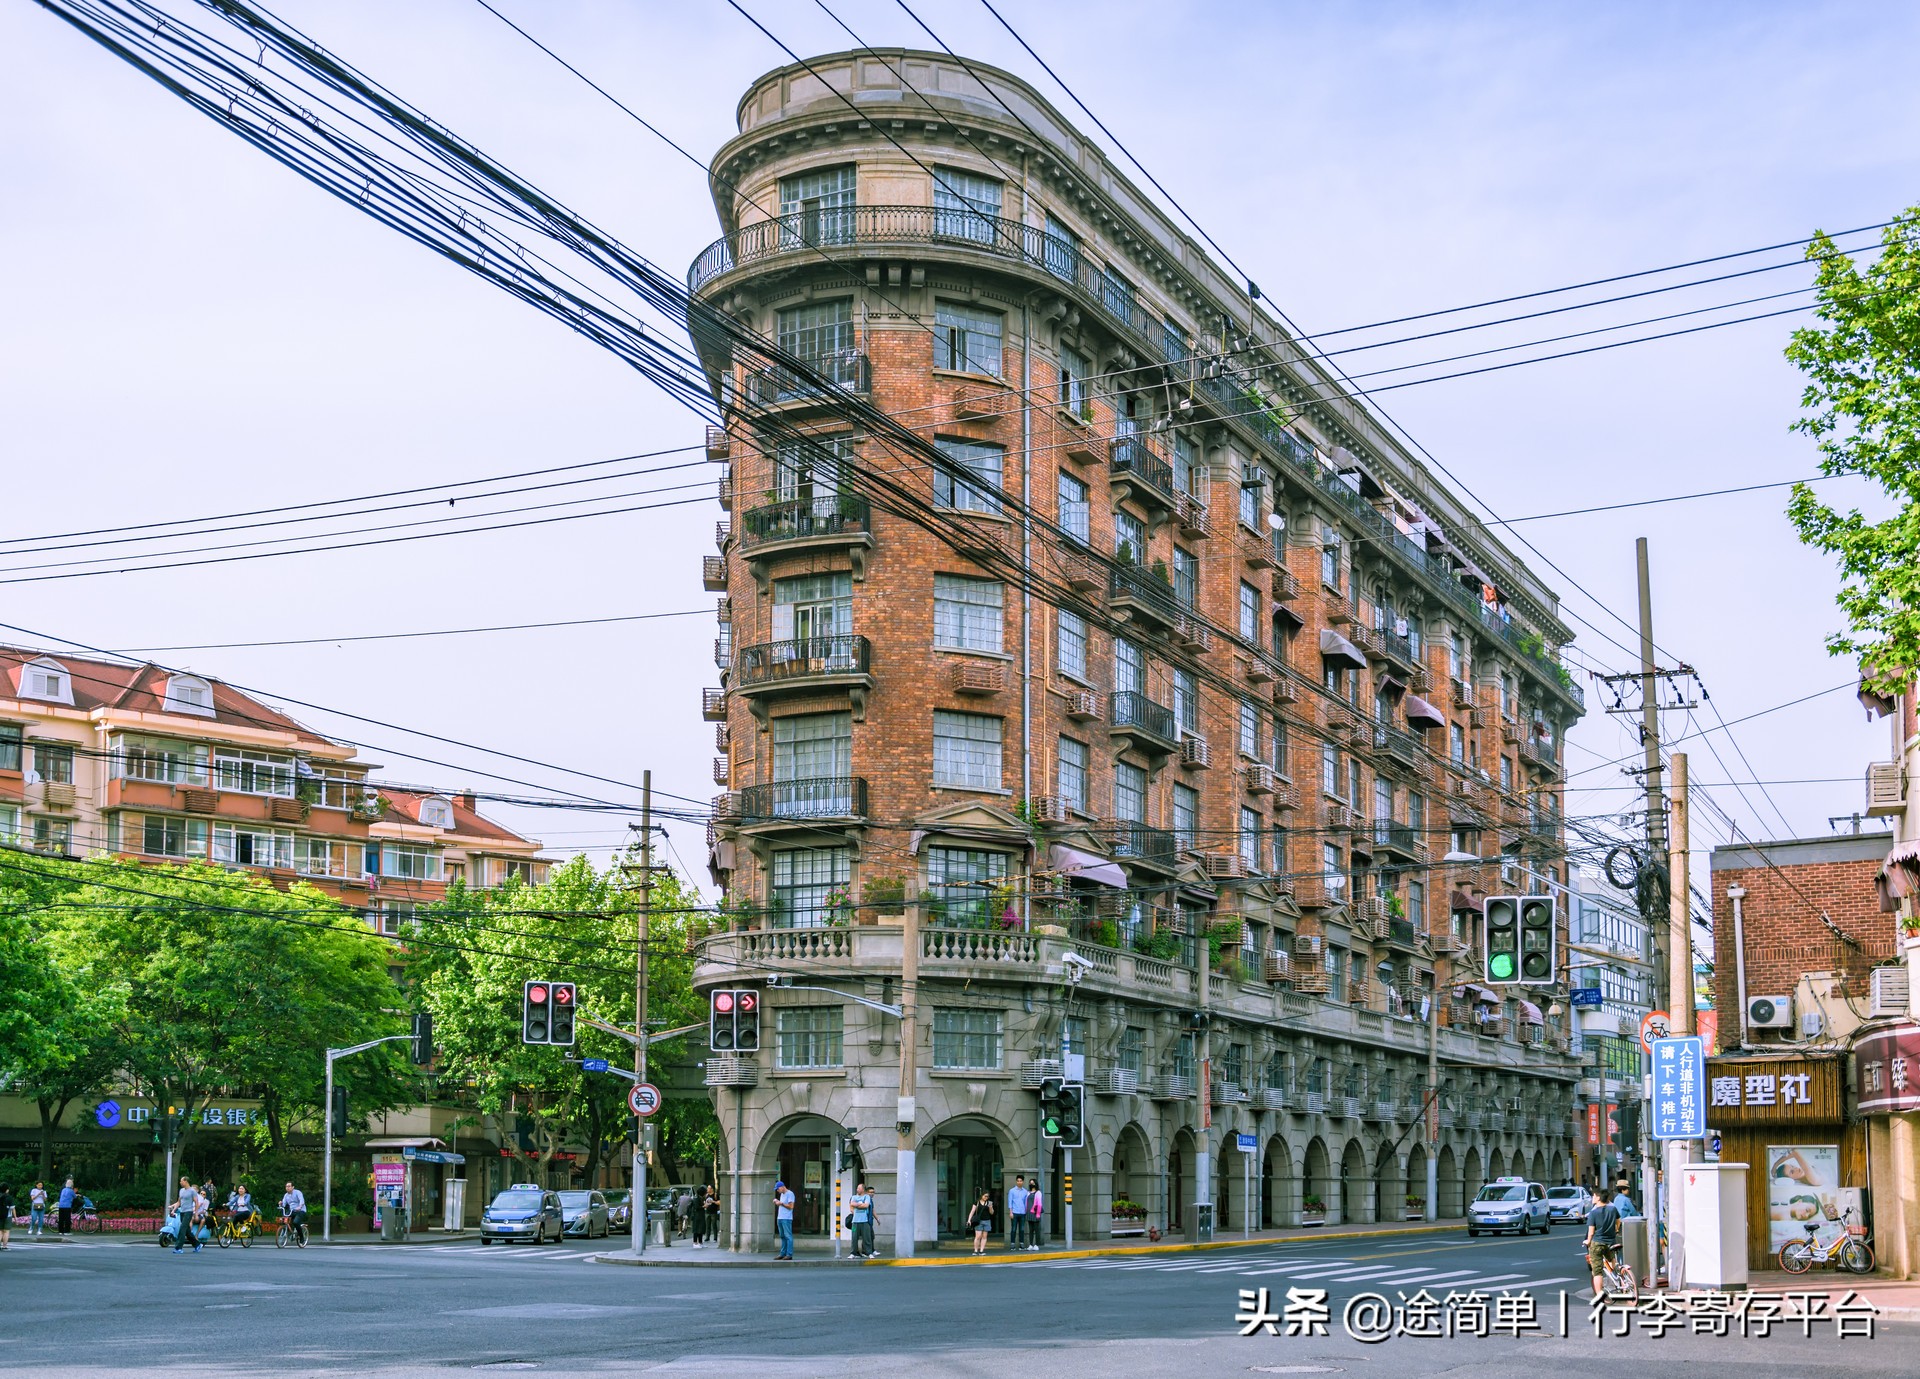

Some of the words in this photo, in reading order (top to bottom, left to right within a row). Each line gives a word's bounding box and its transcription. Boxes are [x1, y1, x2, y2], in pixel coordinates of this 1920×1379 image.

[1660, 1045, 1677, 1133] 请下车推行
[1679, 1042, 1696, 1133] 人行道非机动车
[1710, 1073, 1812, 1106] 魔型社
